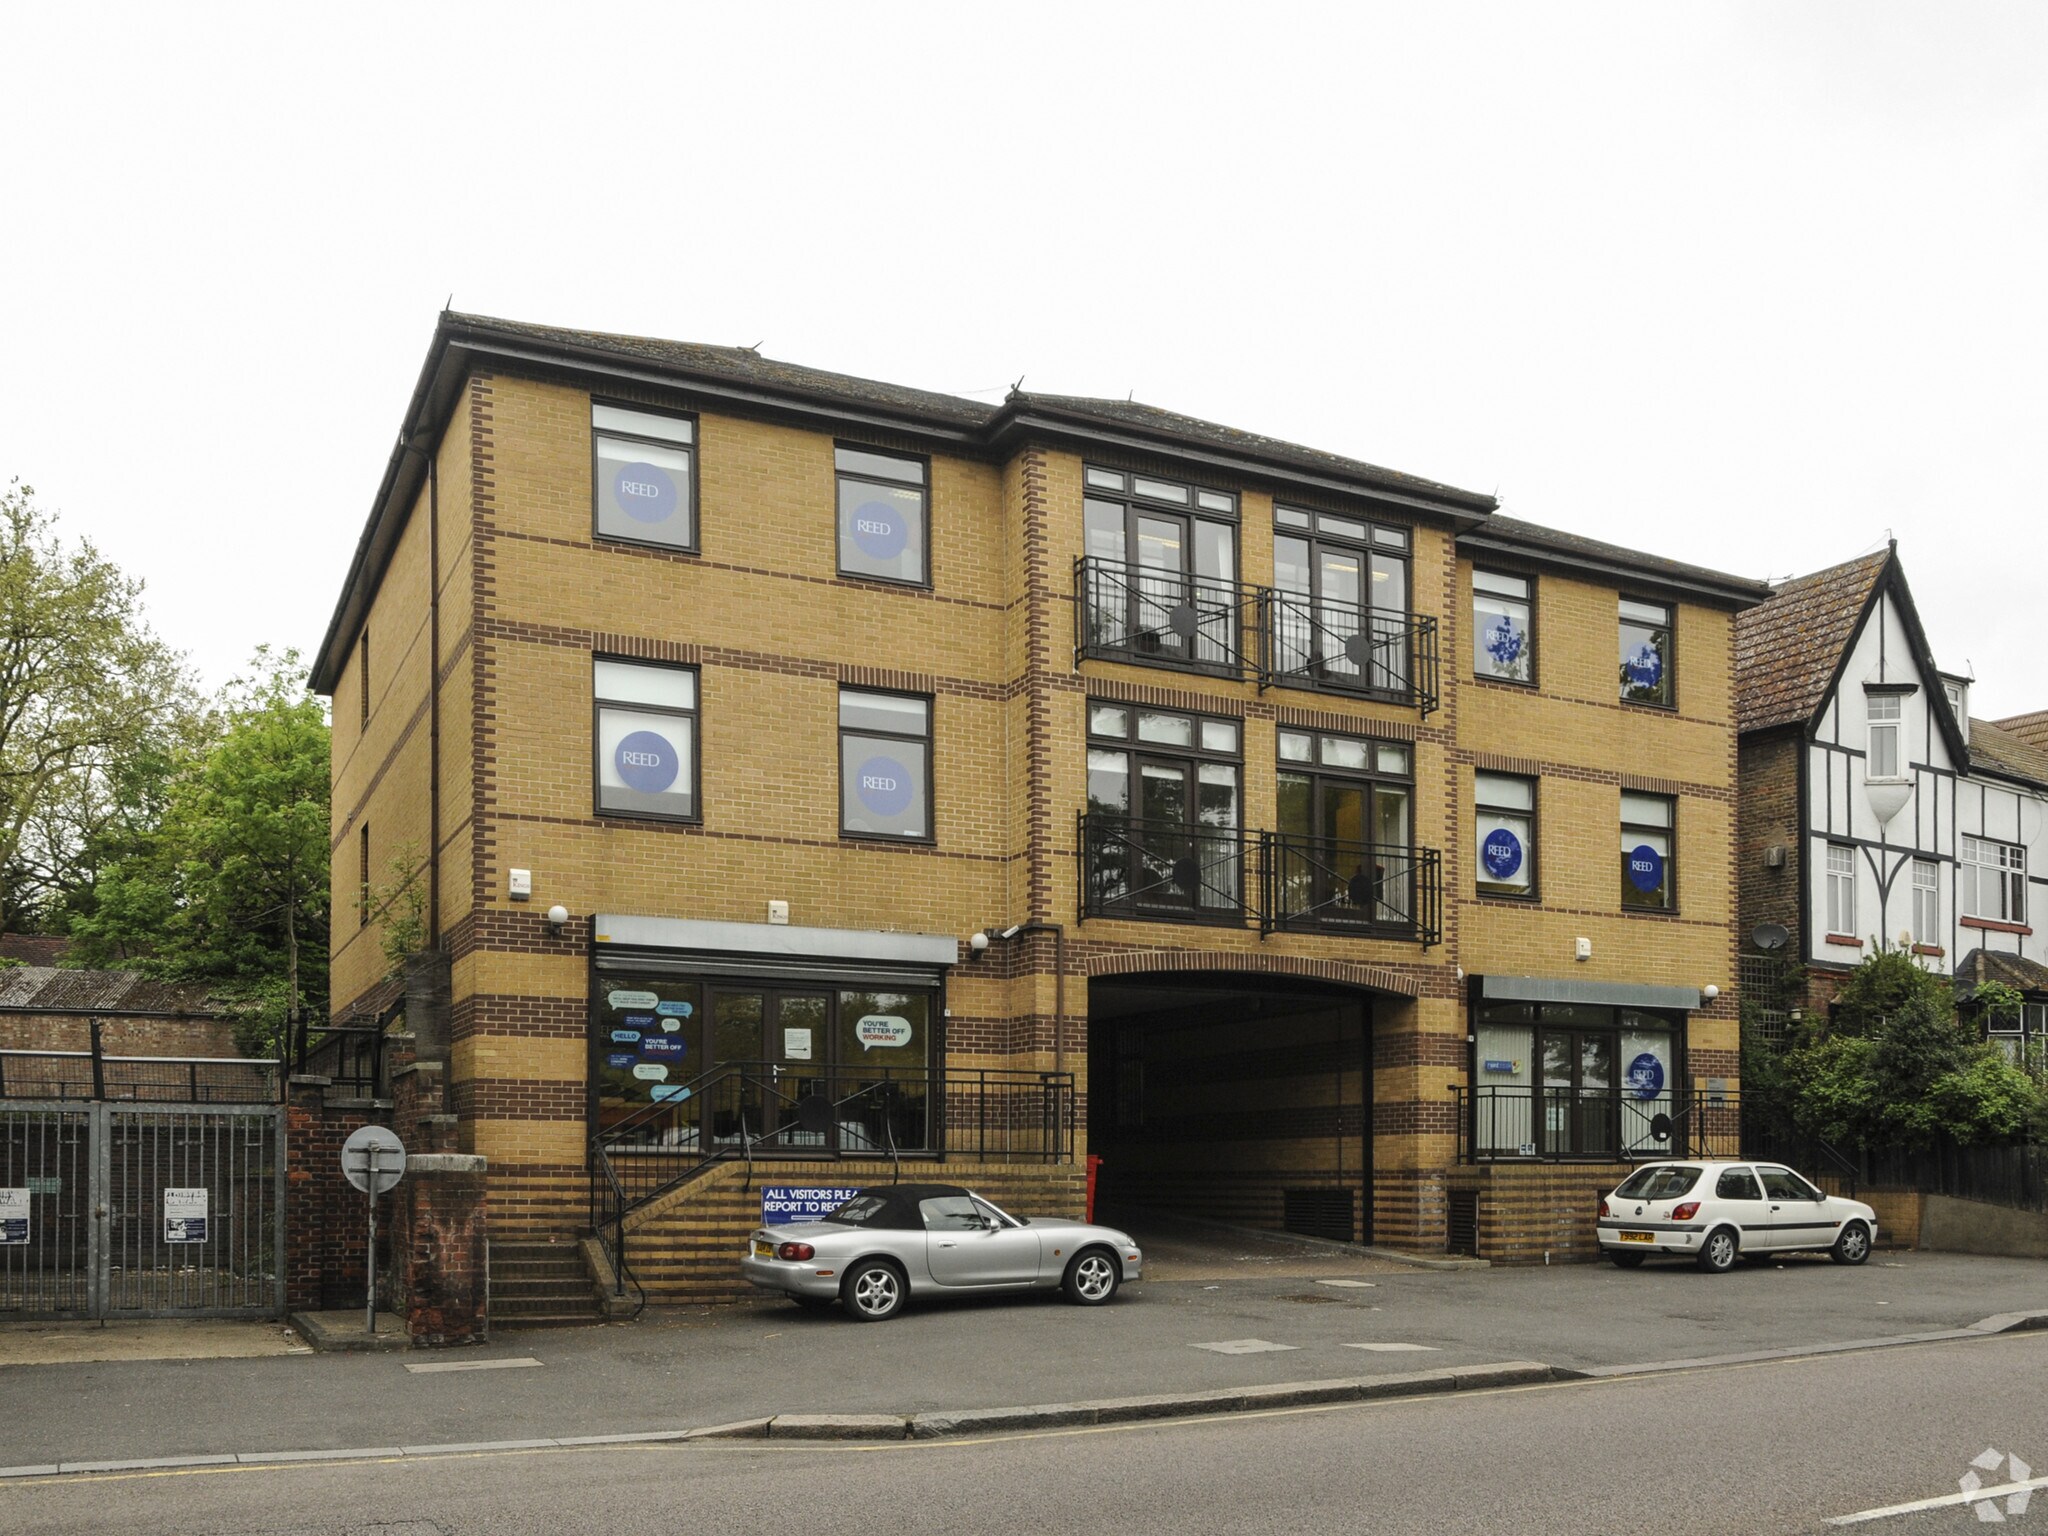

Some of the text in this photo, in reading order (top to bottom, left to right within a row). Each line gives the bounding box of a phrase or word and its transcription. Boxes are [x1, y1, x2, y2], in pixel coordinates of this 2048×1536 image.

[621, 480, 659, 498] REED
[857, 519, 891, 536] REED
[1486, 630, 1509, 642] REED
[1629, 656, 1652, 668] REED
[622, 750, 660, 767] REED
[862, 775, 897, 791] REED
[1487, 844, 1511, 857] REED
[1632, 860, 1653, 872] REED
[863, 1020, 889, 1028] YOU'RE
[766, 1189, 788, 1199] ALL
[789, 1189, 833, 1200] VISITORS
[764, 1201, 802, 1212] REPORT
[804, 1201, 819, 1212] TO
